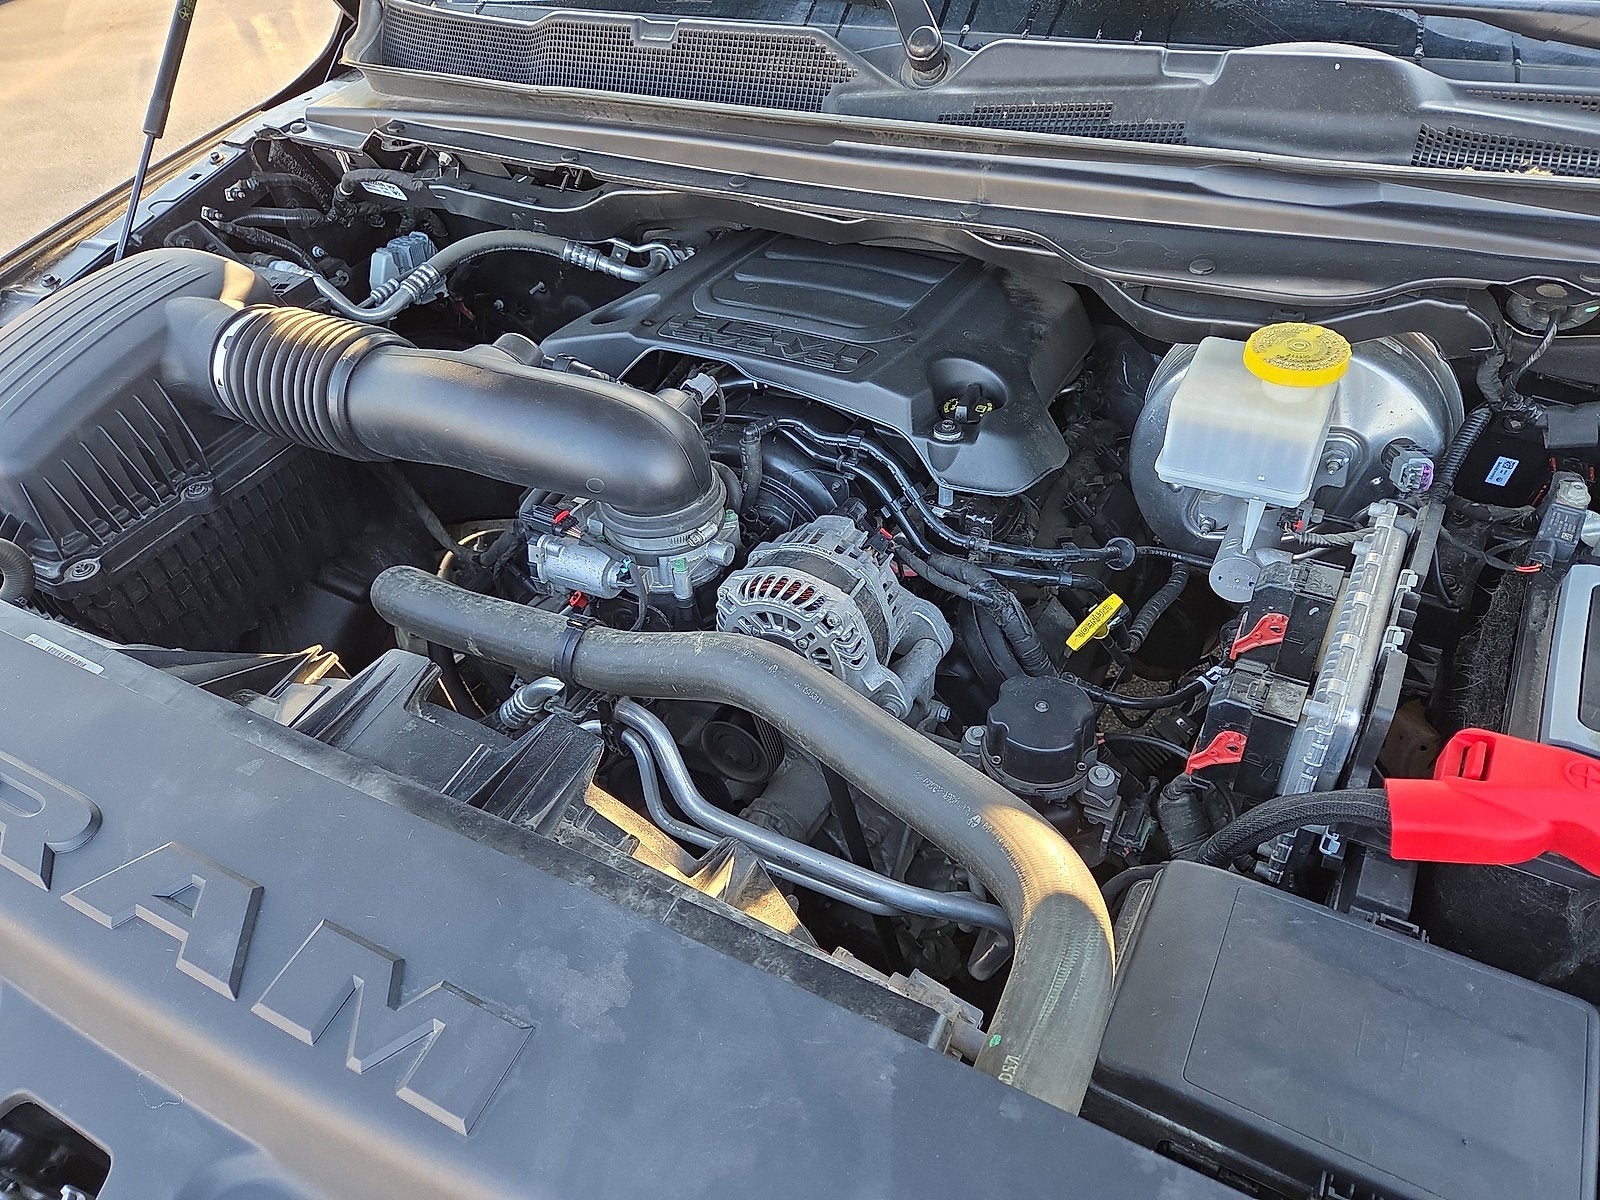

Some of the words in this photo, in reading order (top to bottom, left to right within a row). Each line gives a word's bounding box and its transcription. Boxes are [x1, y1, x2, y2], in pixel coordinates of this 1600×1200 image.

[1087, 603, 1113, 628] ENGINE
[1075, 625, 1090, 638] OIL
[0, 750, 534, 1136] RAM
